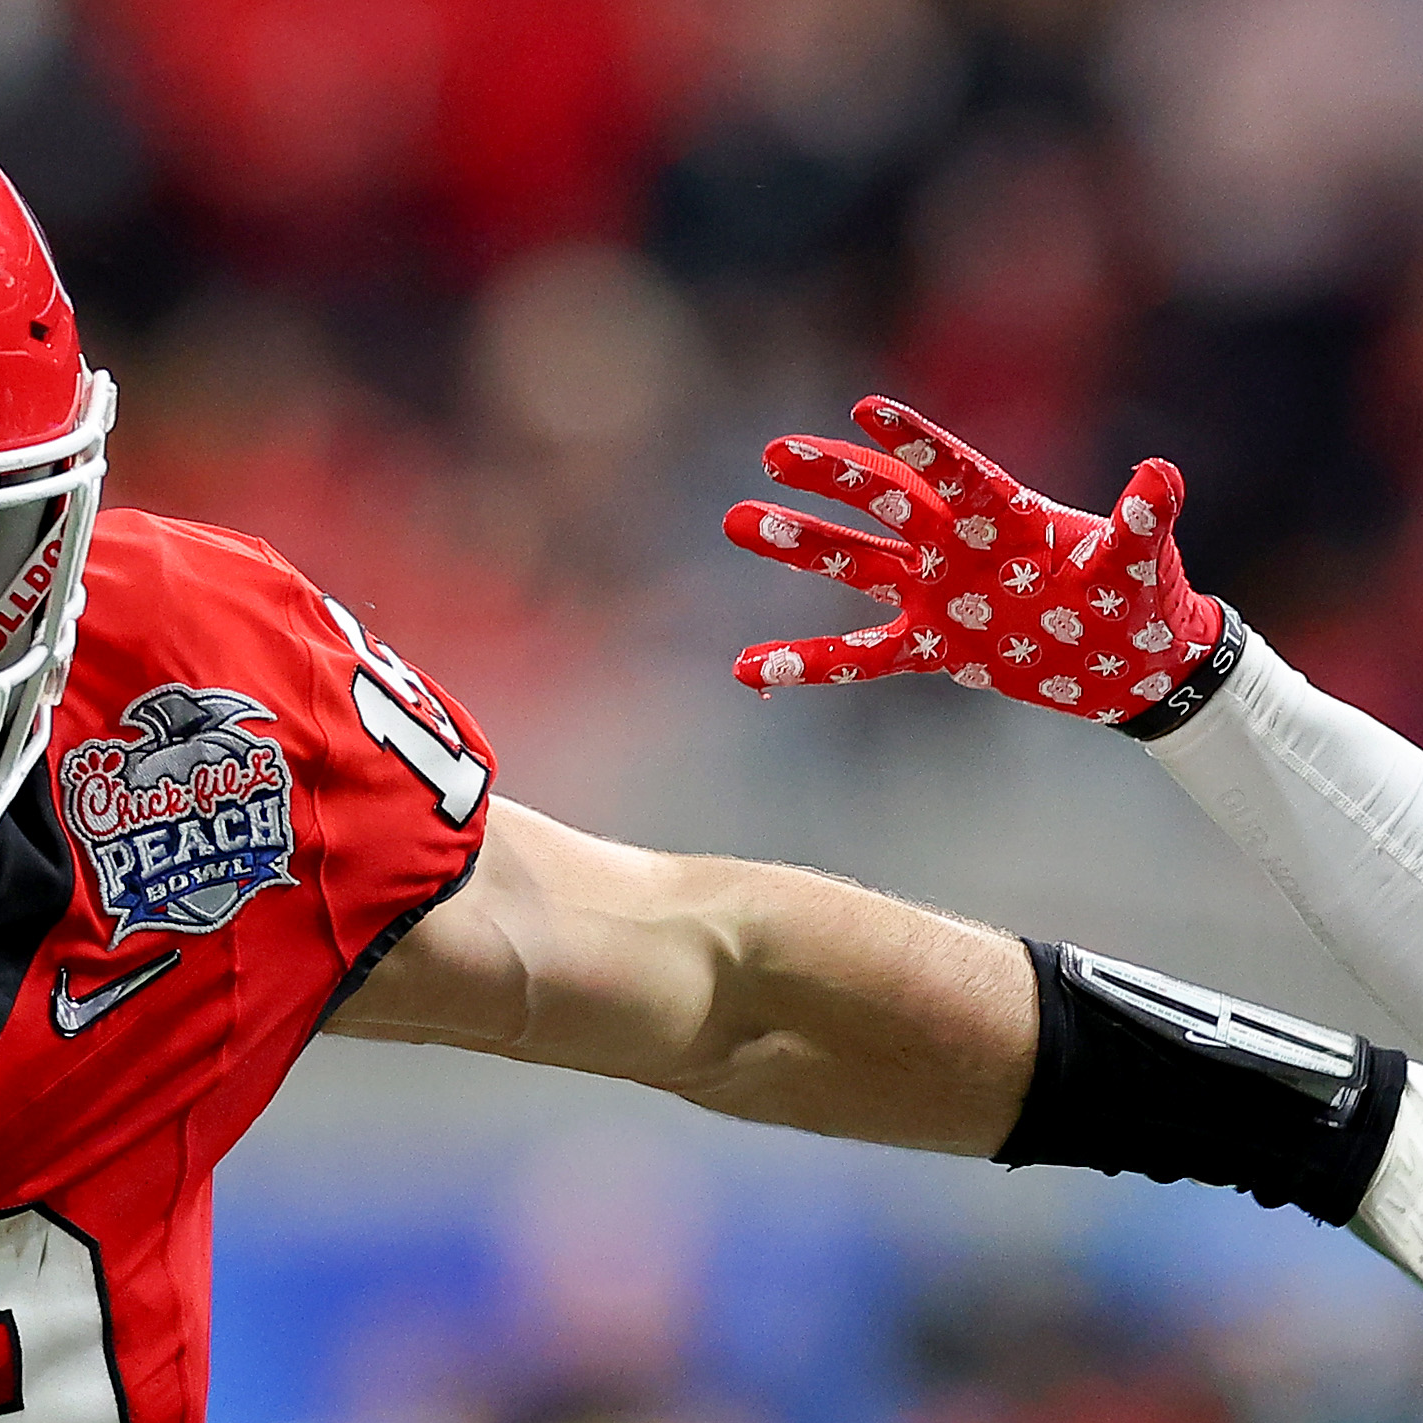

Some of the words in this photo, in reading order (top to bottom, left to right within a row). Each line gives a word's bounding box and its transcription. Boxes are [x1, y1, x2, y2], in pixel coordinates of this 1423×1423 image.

[76, 750, 277, 836] Chick-fil-A
[95, 796, 285, 899] PEACH
[146, 856, 253, 903] BOWL
